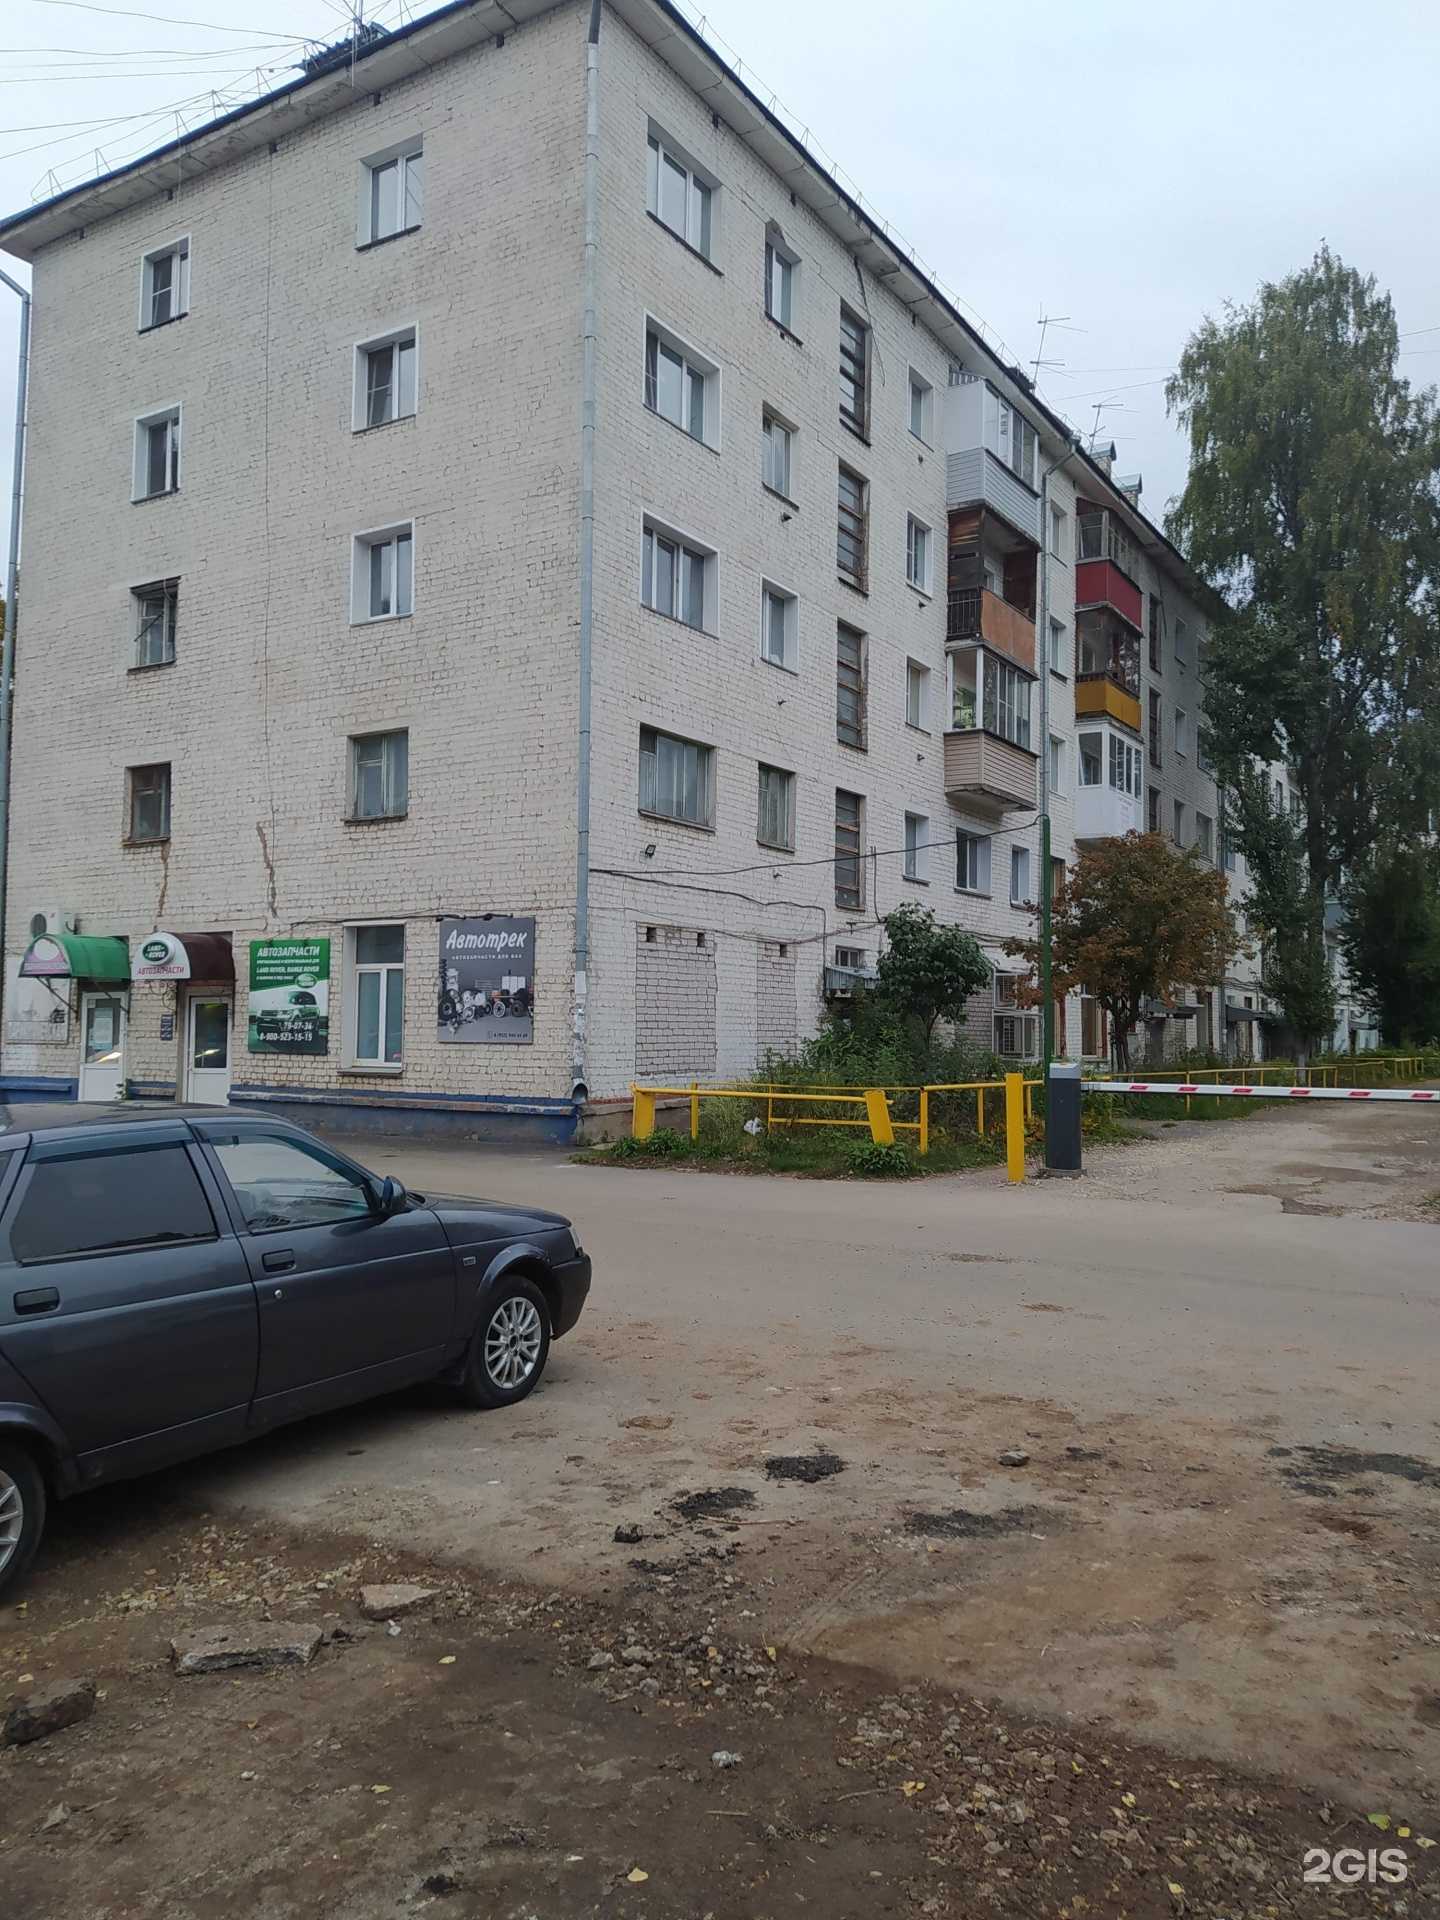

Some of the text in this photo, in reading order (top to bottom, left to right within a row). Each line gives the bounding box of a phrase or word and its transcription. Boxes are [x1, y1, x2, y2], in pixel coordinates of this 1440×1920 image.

[446, 929, 527, 952] Автотрек
[257, 946, 320, 957] АВТОЗАПЧАСТИ
[137, 966, 185, 975] АВТОЗАПЧАСТИ
